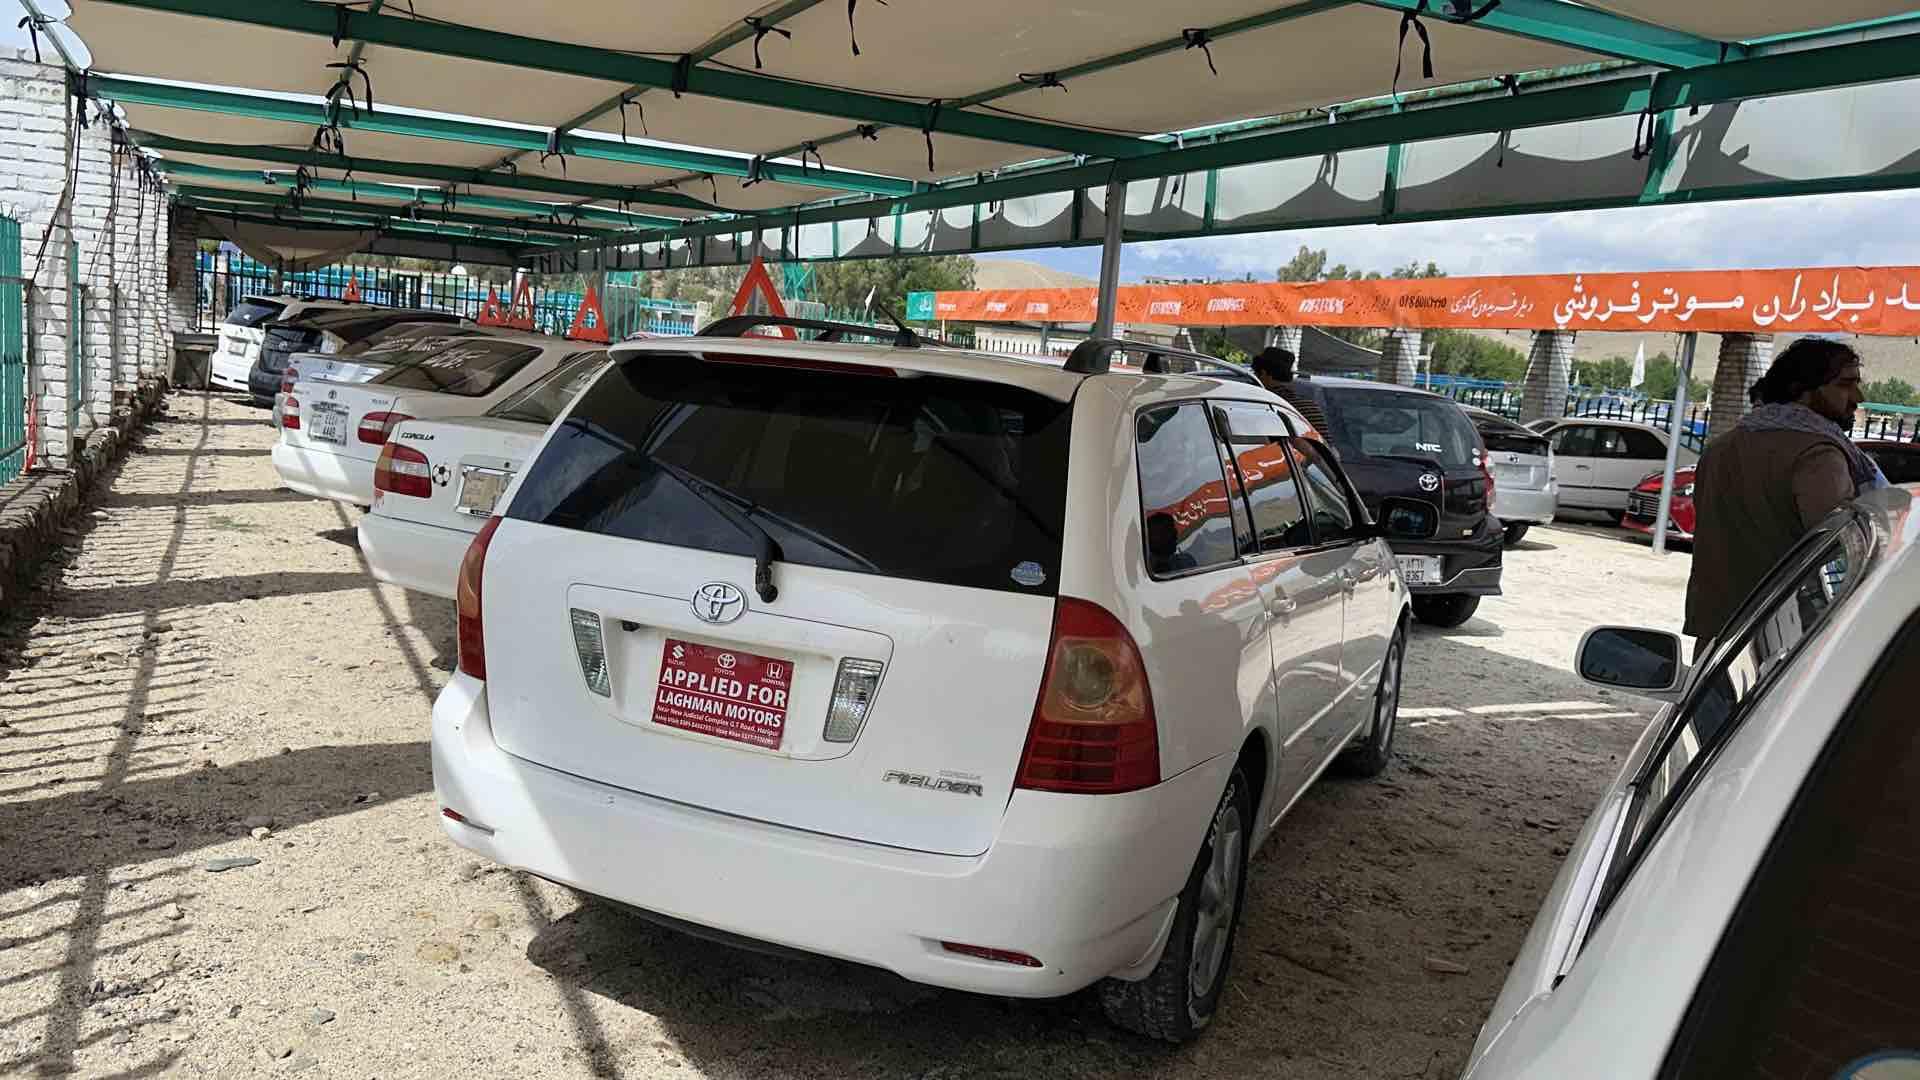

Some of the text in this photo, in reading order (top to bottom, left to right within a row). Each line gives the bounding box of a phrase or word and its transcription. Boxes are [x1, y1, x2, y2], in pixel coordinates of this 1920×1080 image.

[1752, 272, 1875, 327] برادران
[661, 667, 787, 708] APPLIED FOR
[659, 691, 723, 715] LAGHMAN
[724, 704, 782, 728] MOTORS
[881, 771, 984, 797] FIELDER
